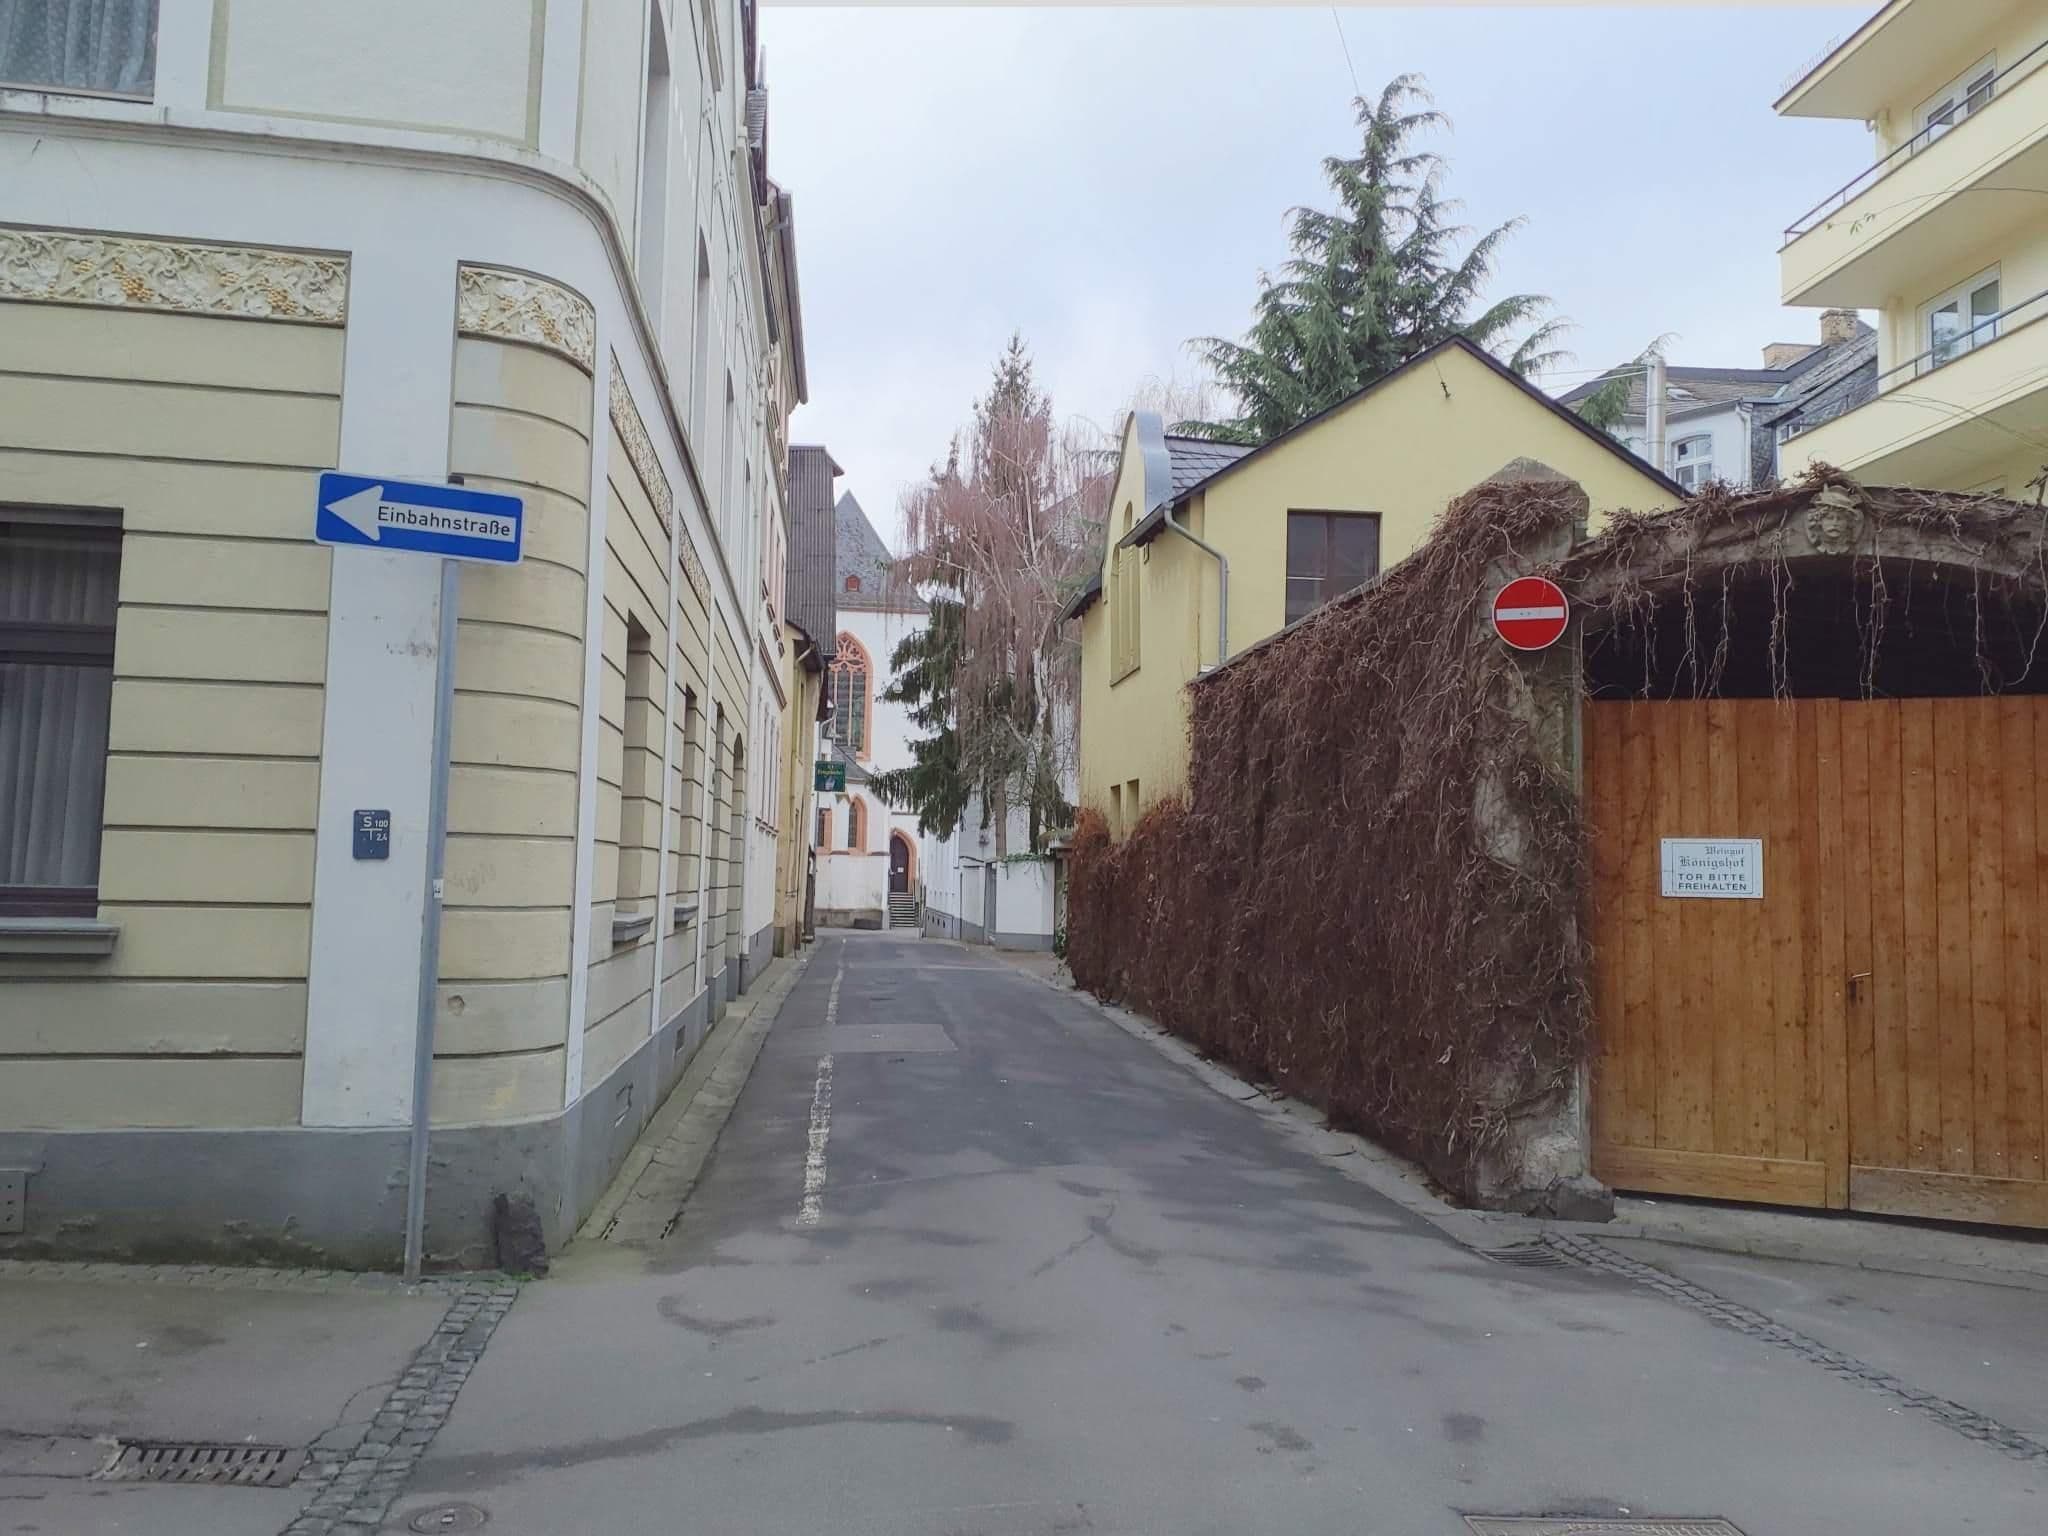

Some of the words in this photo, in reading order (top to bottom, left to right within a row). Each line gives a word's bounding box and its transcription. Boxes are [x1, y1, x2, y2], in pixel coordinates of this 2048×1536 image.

[378, 506, 510, 536] Einbahnstraße
[363, 816, 372, 827] S
[375, 819, 389, 828] 100
[1704, 846, 1745, 856] Weingut
[1679, 856, 1745, 870] Königshof
[1678, 873, 1703, 881] TOR
[1708, 873, 1745, 882] BITTE
[1678, 882, 1747, 891] FREIHALTEN
